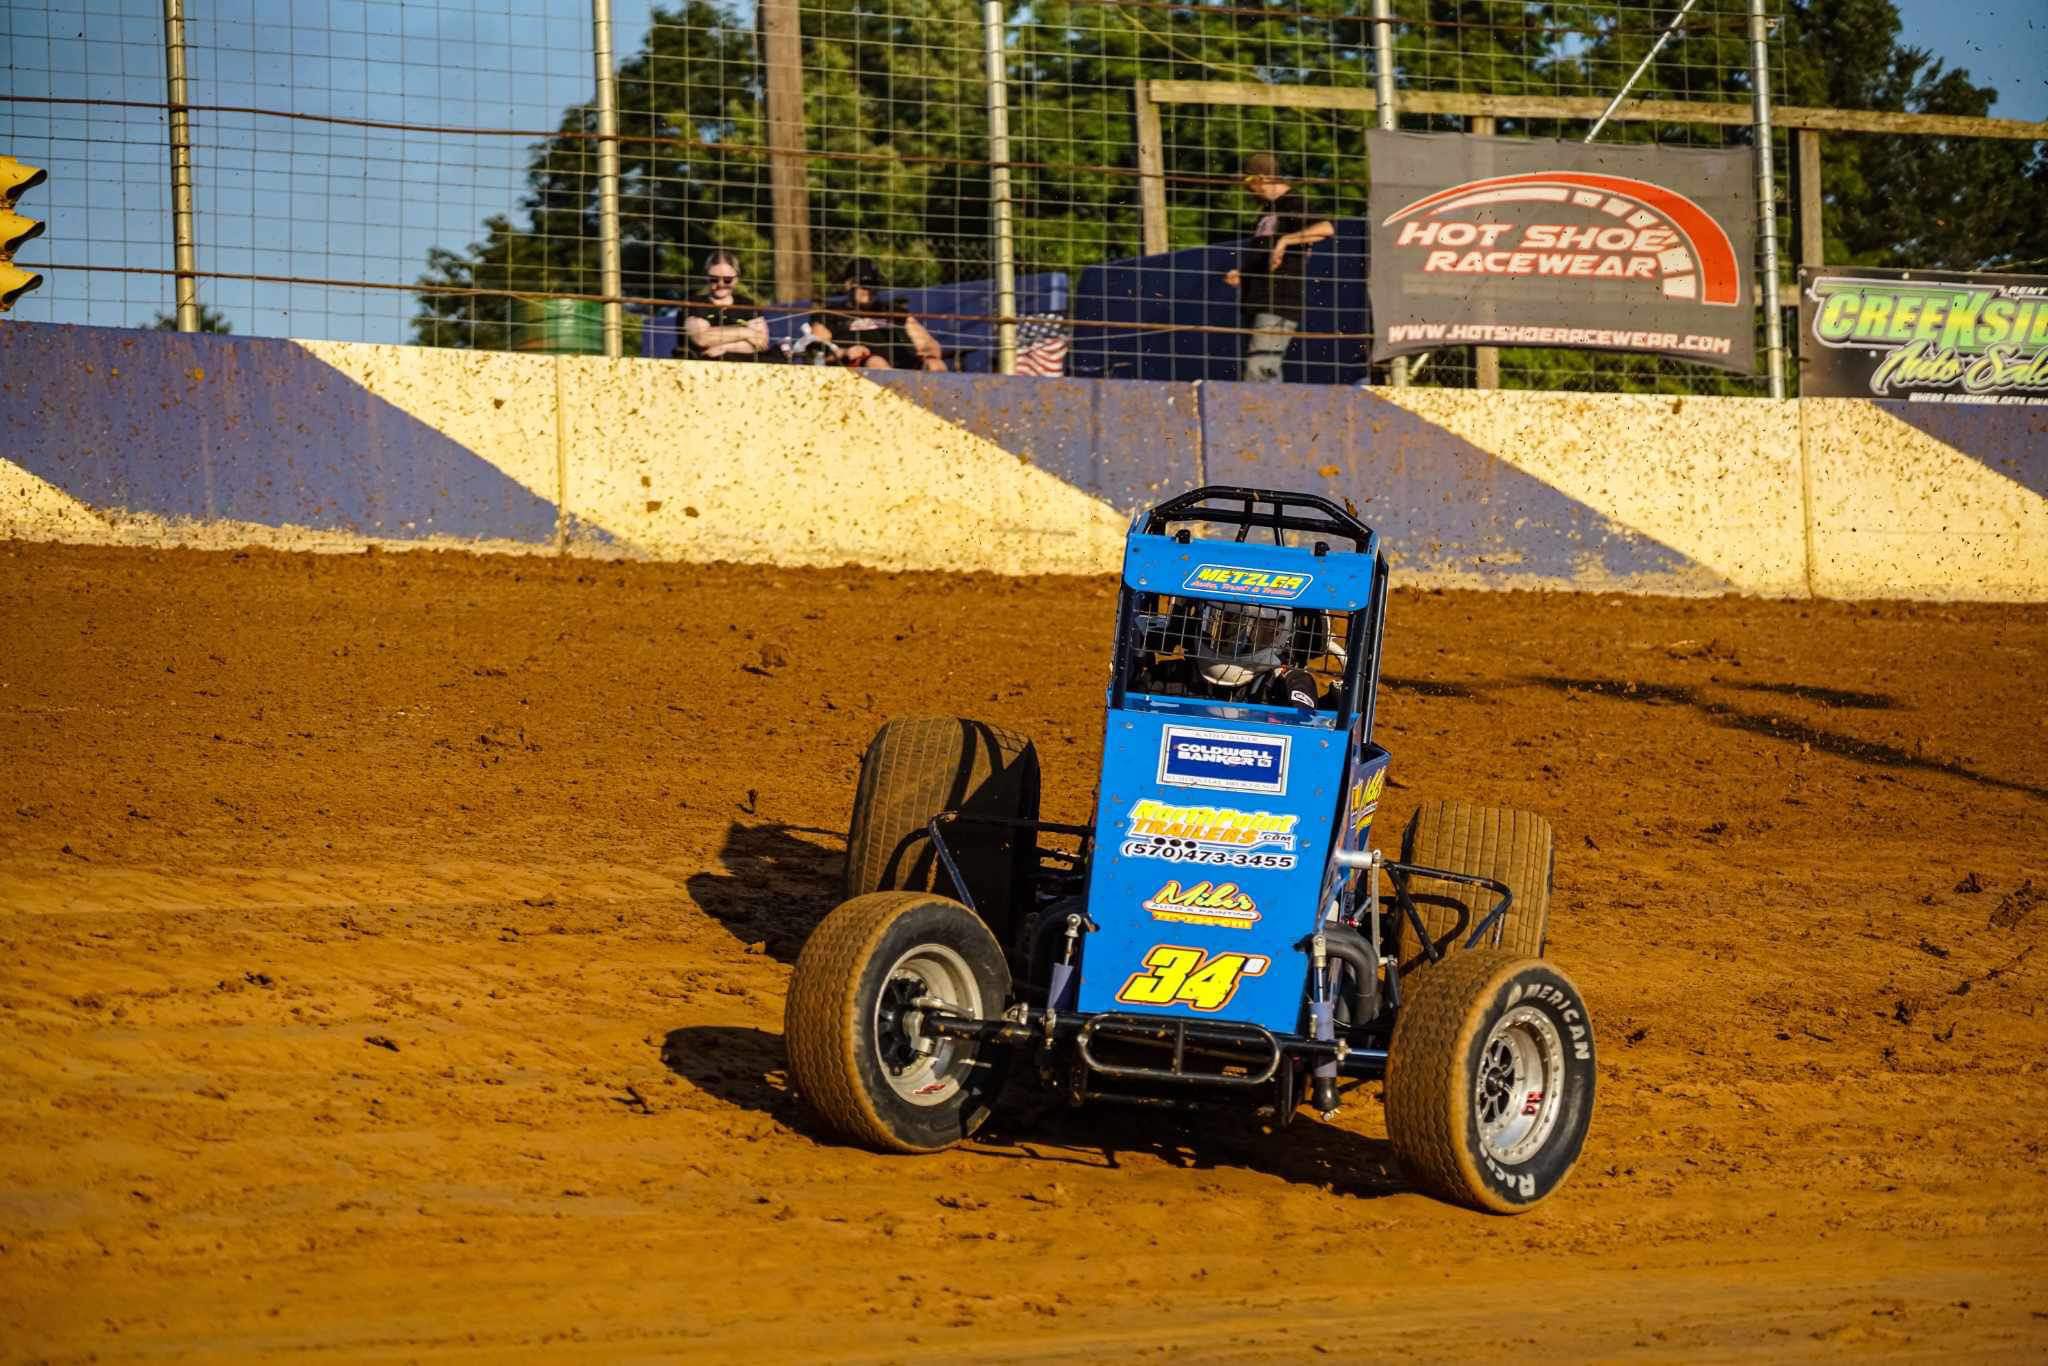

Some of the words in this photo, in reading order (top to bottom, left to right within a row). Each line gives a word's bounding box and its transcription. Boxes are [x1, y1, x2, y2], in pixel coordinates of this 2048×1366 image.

[1398, 221, 1513, 248] HOT
[1521, 223, 1674, 252] SHOE
[1425, 251, 1657, 278] RACEWEAR
[1388, 324, 1731, 354] WWW.HOTSHOERACEWEAR.COM
[1198, 568, 1304, 590] METZLER
[1178, 743, 1273, 760] COLDWELL
[1178, 751, 1255, 766] BANKER
[1133, 819, 1259, 844] TRAILERS
[1124, 842, 1293, 868] (570)473-3455
